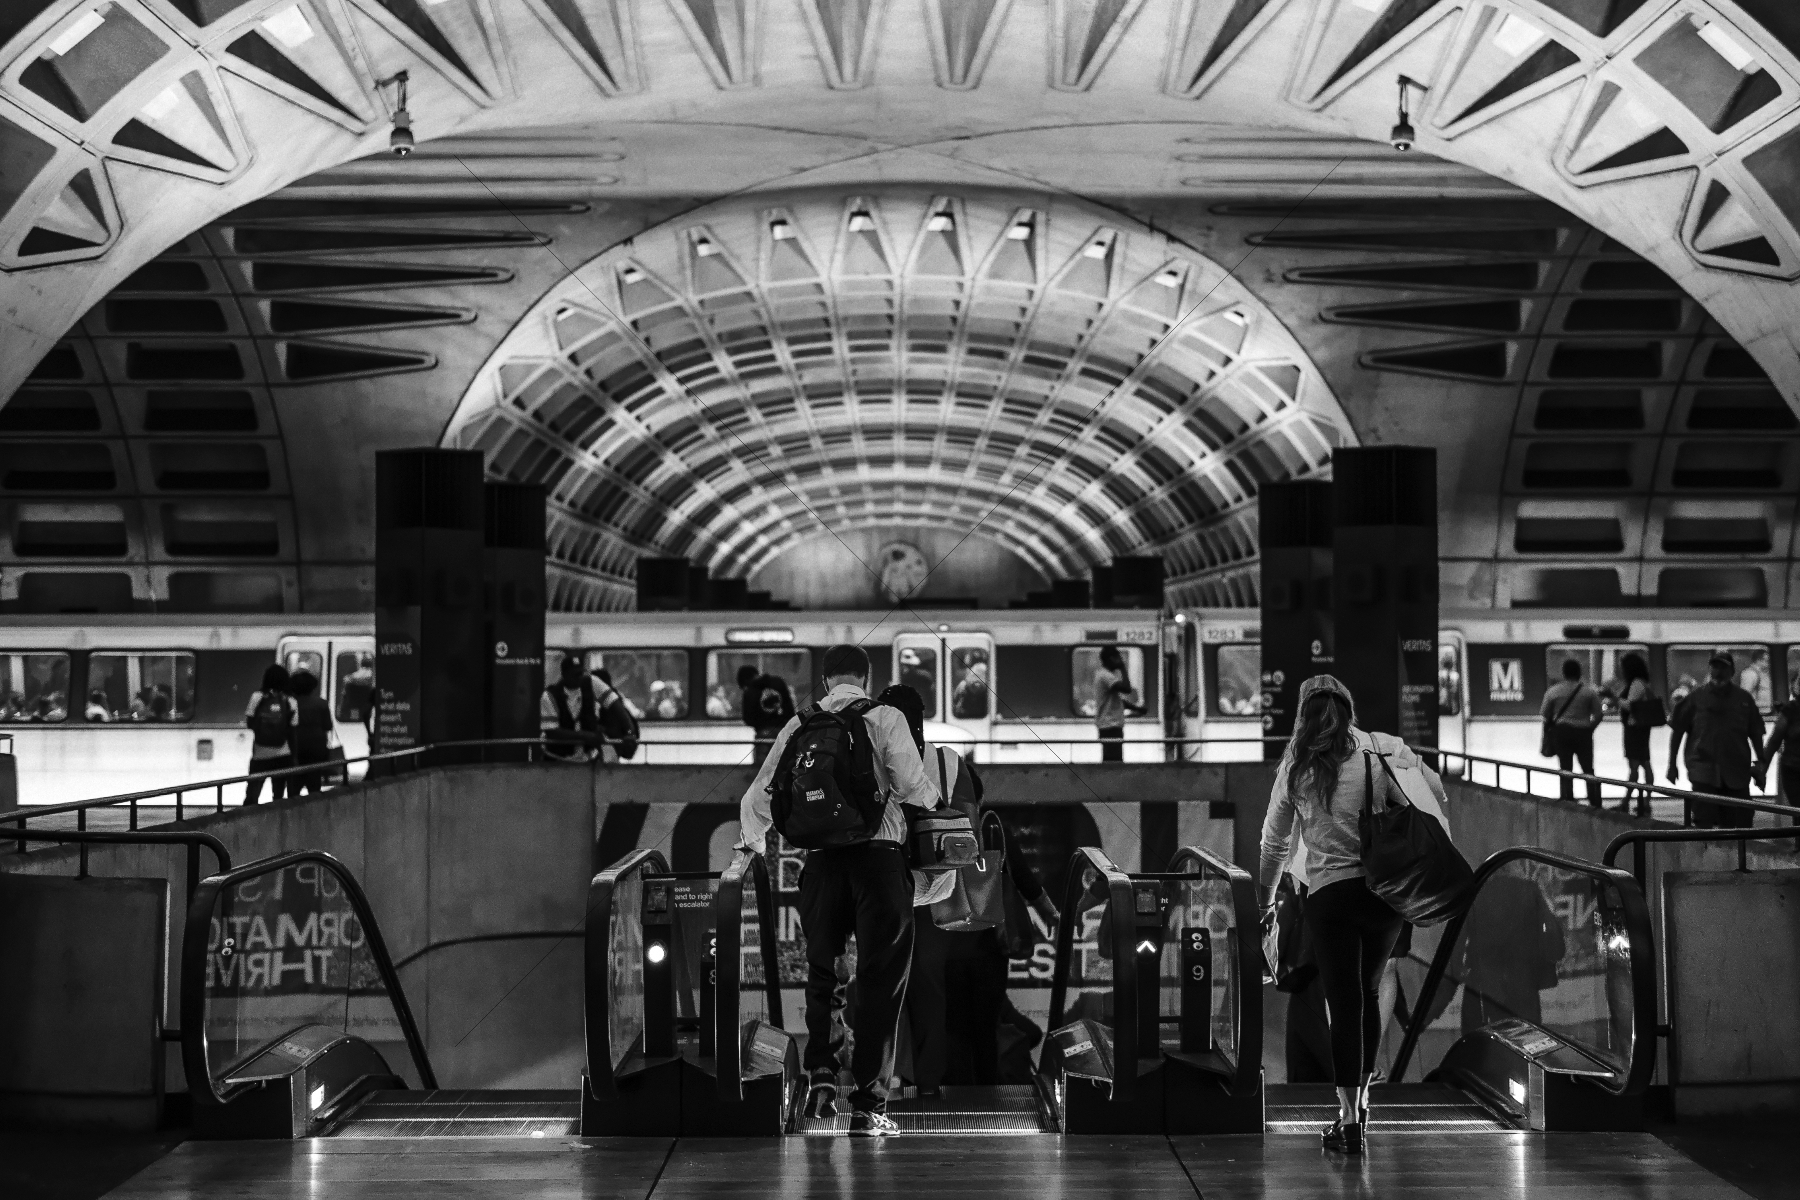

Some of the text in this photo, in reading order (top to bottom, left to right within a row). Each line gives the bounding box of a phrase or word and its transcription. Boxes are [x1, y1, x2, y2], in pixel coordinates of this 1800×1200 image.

[1125, 631, 1153, 641] 1282
[1208, 629, 1236, 640] 1283
[380, 643, 412, 655] VERITAS
[1402, 639, 1432, 651] VERITAS
[1490, 660, 1519, 691] M
[1490, 692, 1524, 701] metro
[697, 893, 713, 902] right
[1192, 964, 1205, 981] 9
